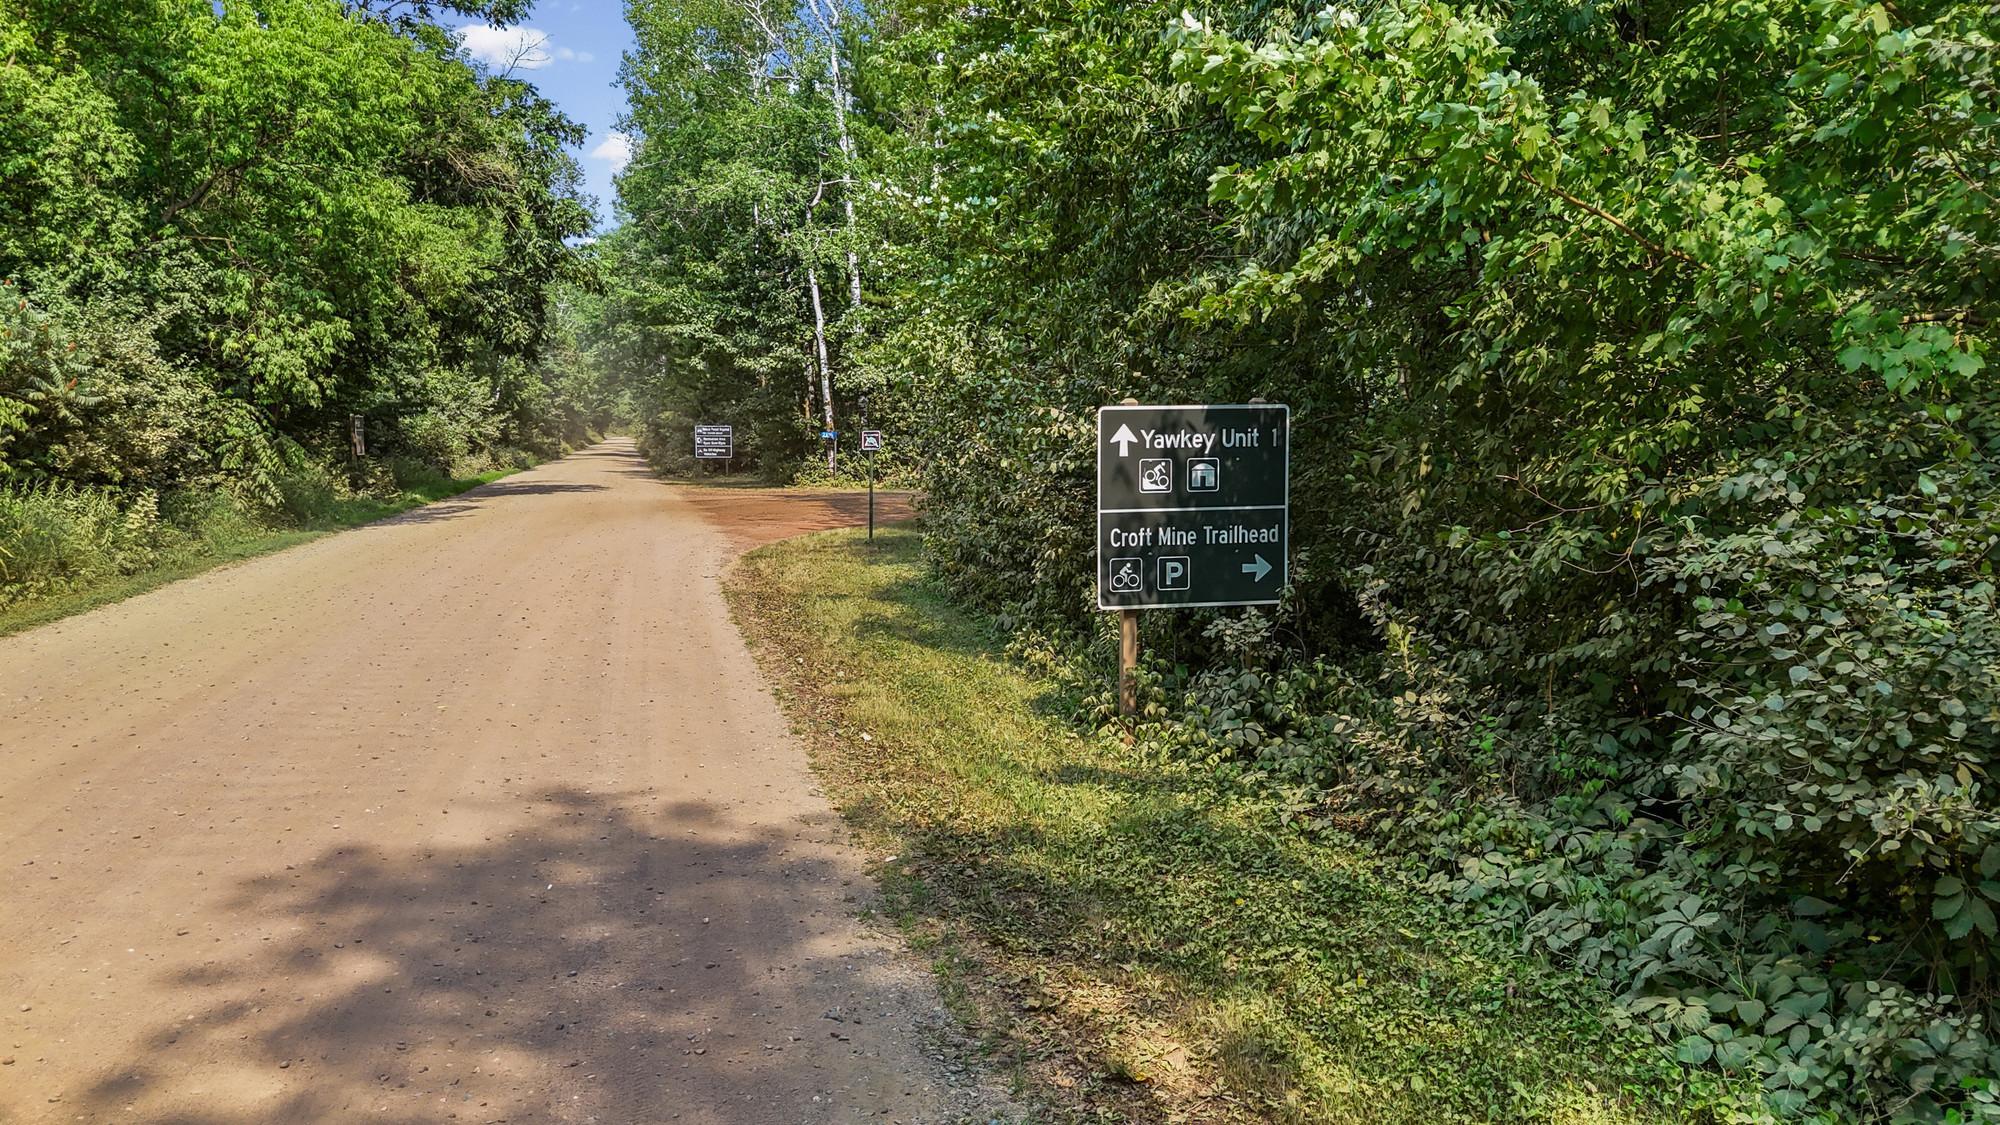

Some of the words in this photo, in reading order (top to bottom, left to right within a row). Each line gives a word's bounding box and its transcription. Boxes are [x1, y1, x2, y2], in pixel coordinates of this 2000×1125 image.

[1140, 429, 1216, 454] Yawkey
[1222, 428, 1259, 448] Unit
[1271, 428, 1278, 447] 1
[1110, 527, 1152, 547] Croft
[1158, 527, 1197, 546] Mine
[1203, 524, 1279, 545] Trailhead
[1165, 561, 1184, 585] P
